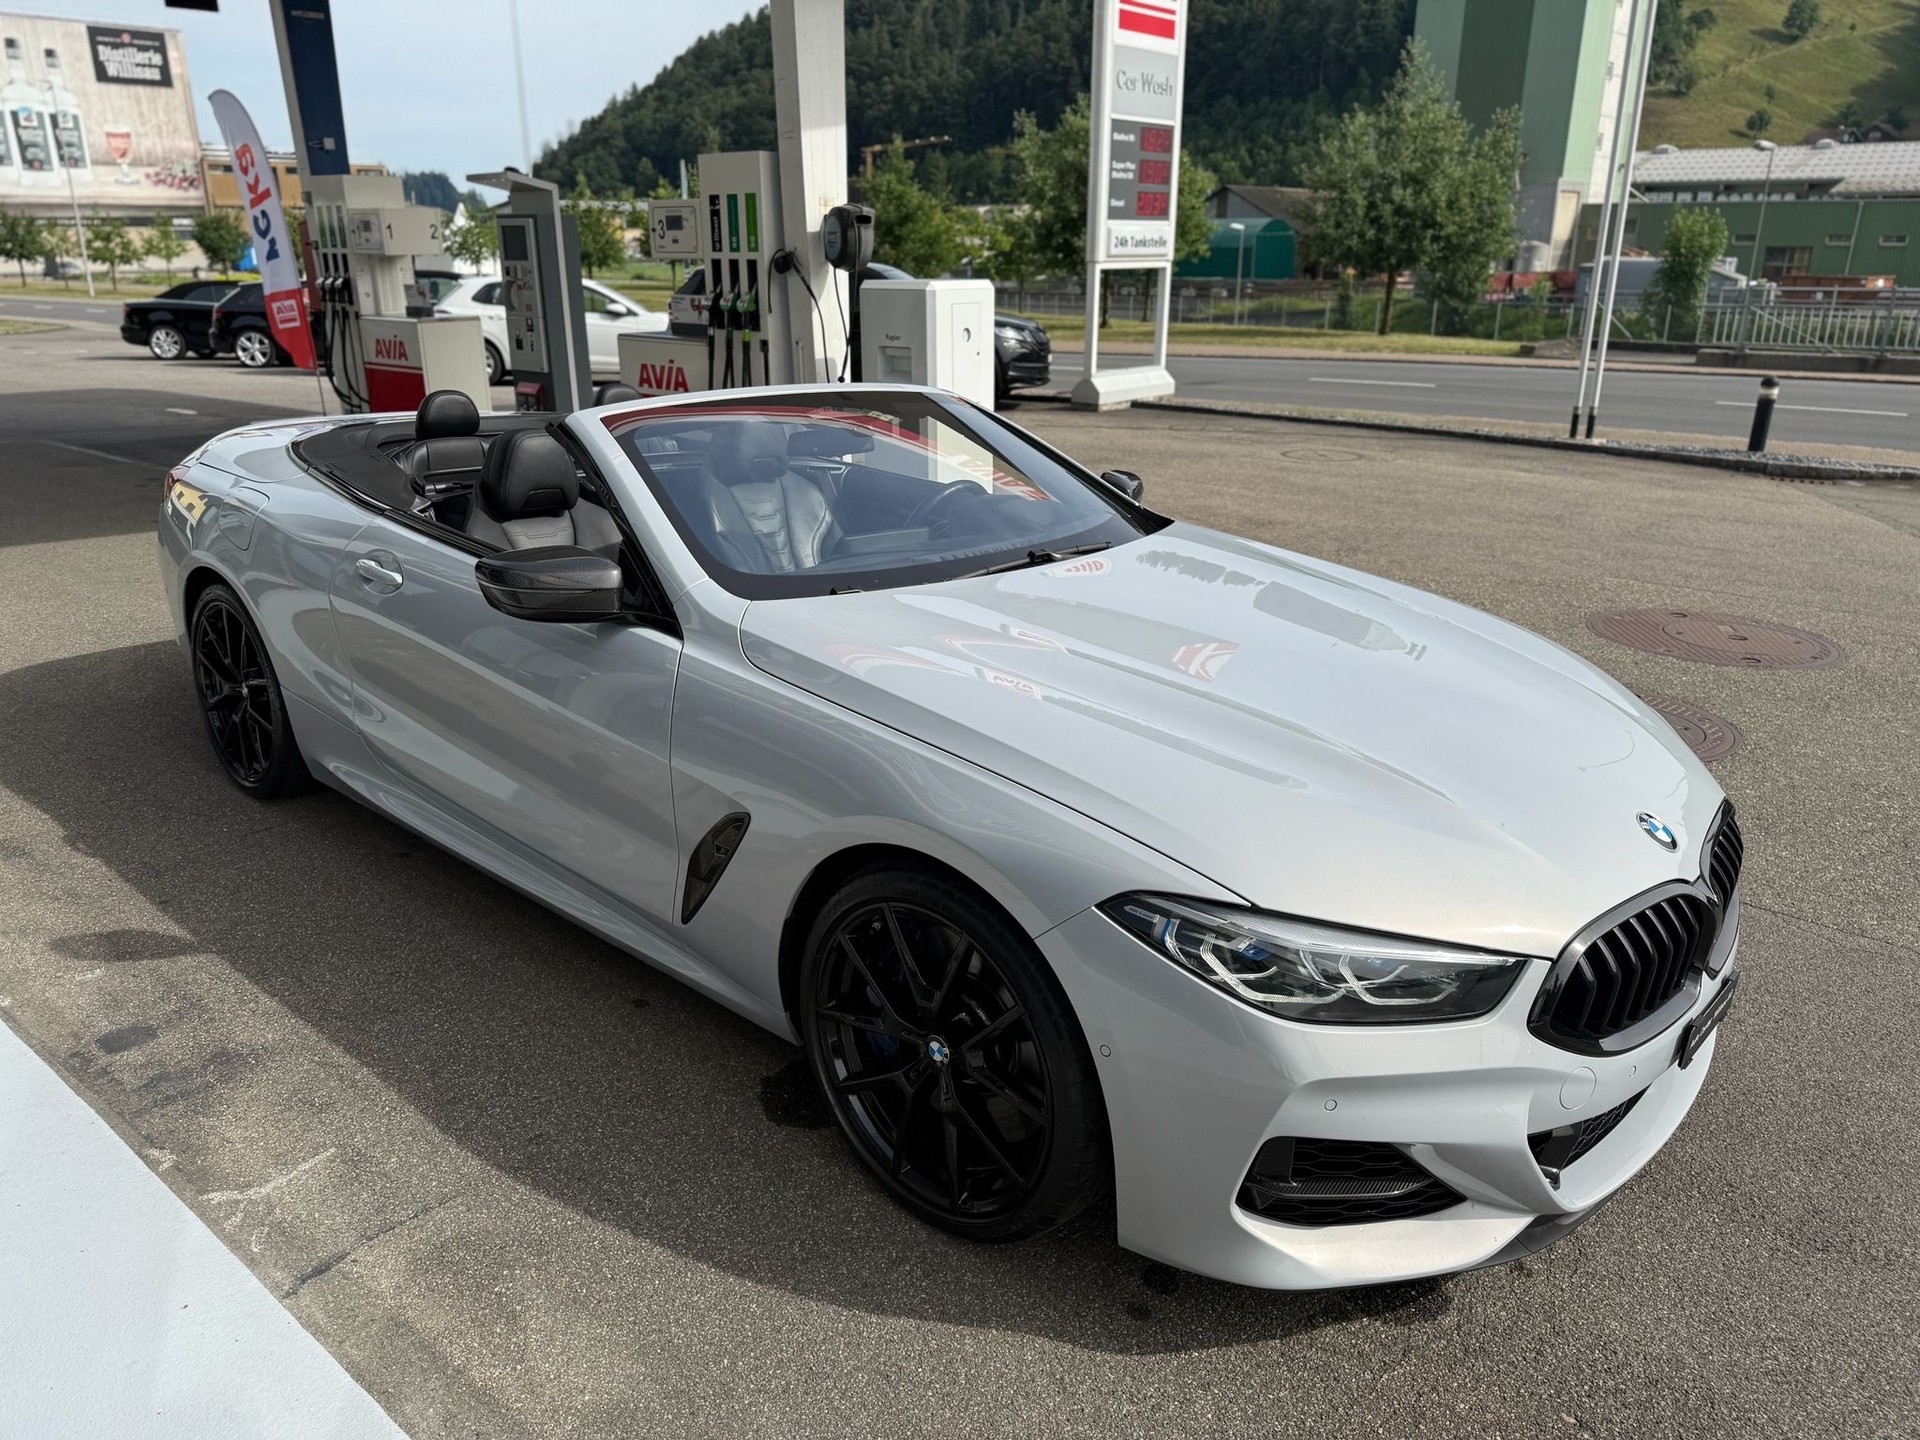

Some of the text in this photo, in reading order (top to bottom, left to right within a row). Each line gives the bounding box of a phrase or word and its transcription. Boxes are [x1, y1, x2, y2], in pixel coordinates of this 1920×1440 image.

[1116, 69, 1173, 96] Car Wash
[385, 223, 394, 240] 1
[429, 223, 439, 240] 2
[657, 218, 666, 240] 3
[1114, 235, 1168, 249] 24h Tankstelle
[375, 334, 409, 362] AVIA
[638, 359, 690, 393] AVIA
